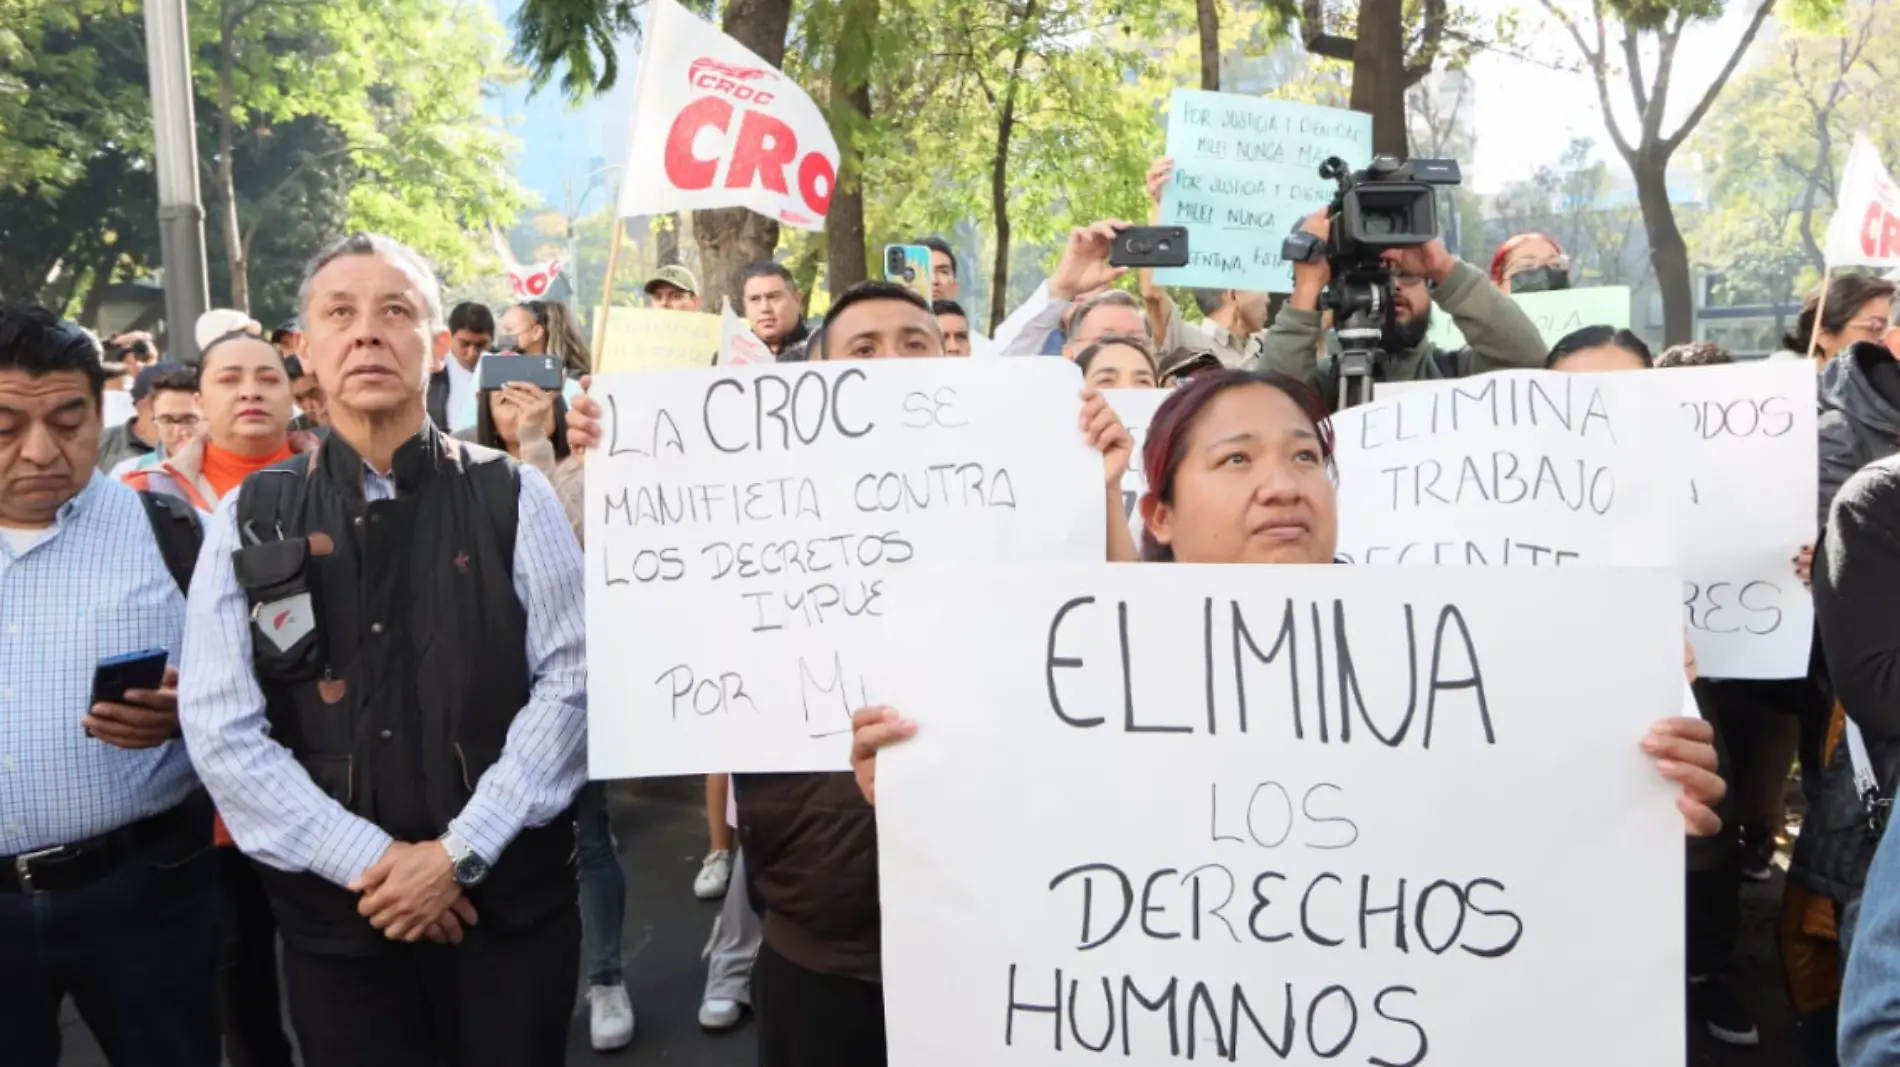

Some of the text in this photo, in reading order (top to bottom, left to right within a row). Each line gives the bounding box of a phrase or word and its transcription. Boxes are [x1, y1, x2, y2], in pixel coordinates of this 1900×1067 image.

[695, 74, 775, 106] CROC
[1184, 100, 1211, 128] POR
[1221, 109, 1277, 134] JUSTICIA
[664, 96, 836, 217] CRO
[1237, 140, 1284, 161] NUNCA
[1176, 169, 1201, 190] POR
[1209, 177, 1265, 196] JUSTICIA
[1177, 200, 1275, 228] MILEI NUNCA
[1861, 200, 1900, 258] CR
[1188, 250, 1246, 275] GENTINA,
[607, 366, 970, 458] LA CROC SE
[1361, 374, 1618, 450] ELIMINA
[603, 462, 1017, 527] MANIFIETA CONTRA
[1380, 450, 1616, 516] TRABAJO
[603, 530, 915, 587] LOS DECRETOS
[740, 578, 885, 633] IMPUE
[1684, 580, 1783, 635] RES
[653, 648, 868, 723] POR MI
[1045, 595, 1497, 750] ELIMINA
[1211, 780, 1360, 850] LOS
[1047, 862, 1525, 959] DERECHOS
[1004, 963, 1431, 1067] HUMANOS
